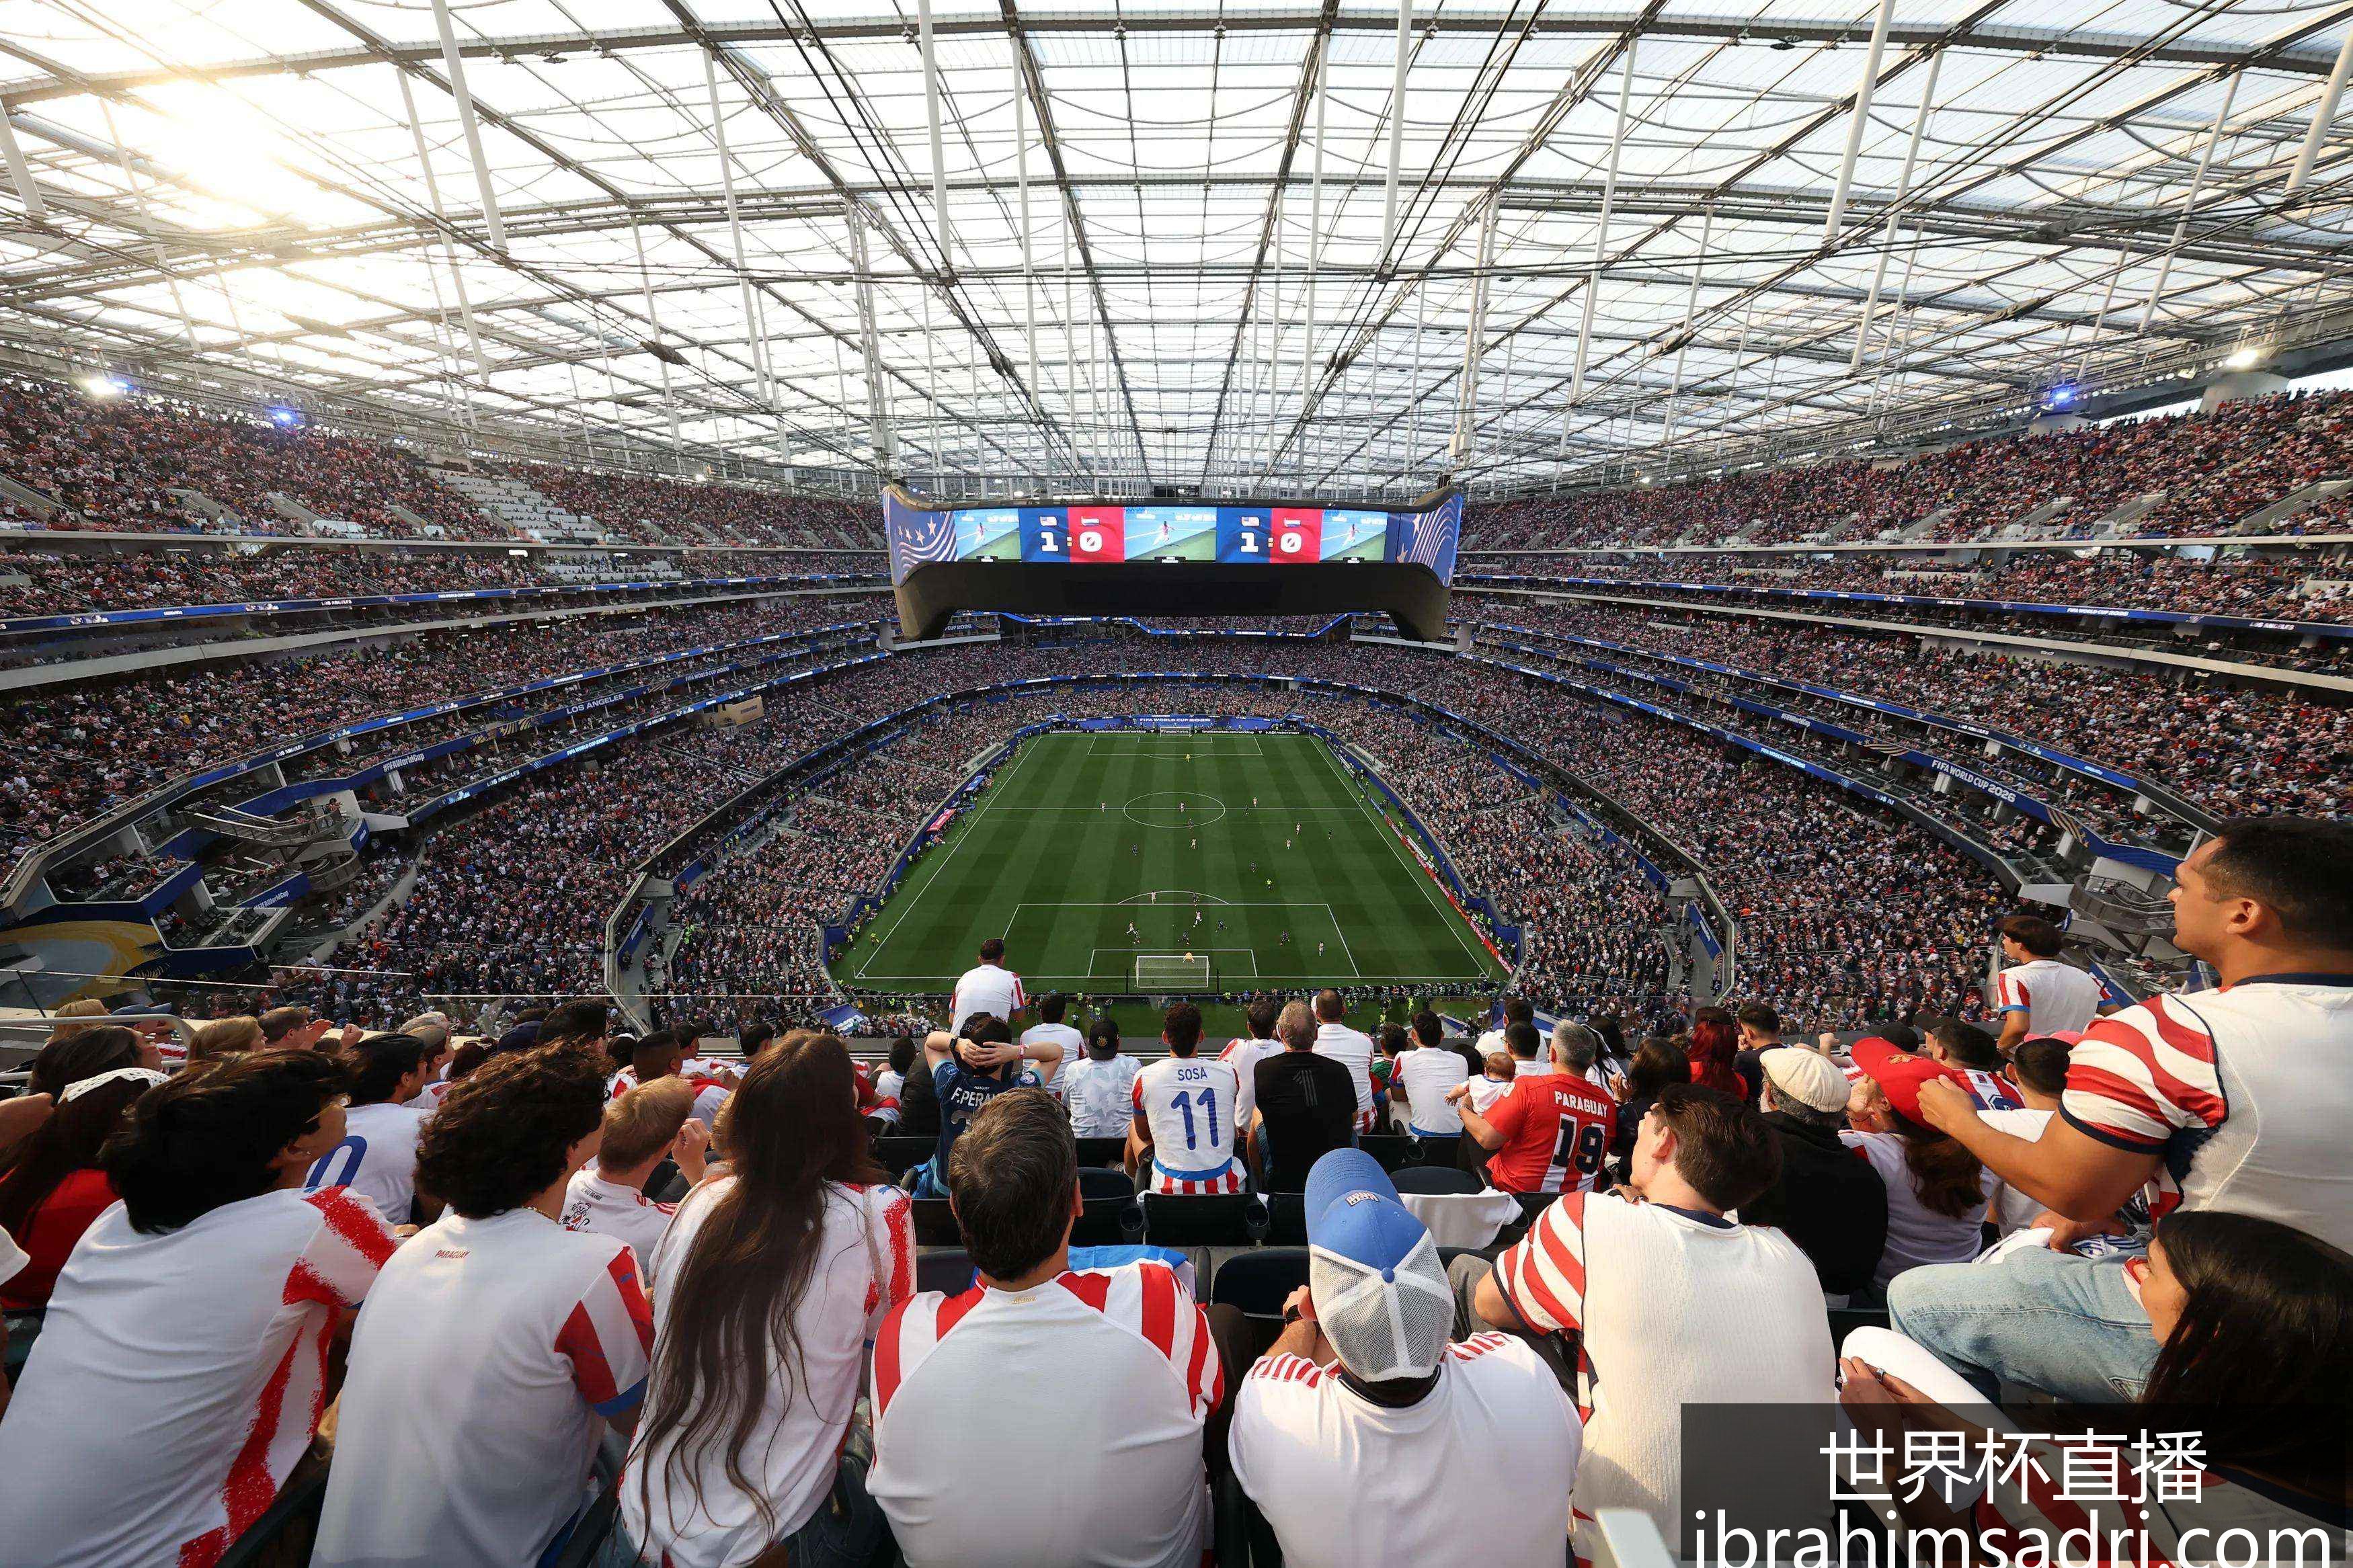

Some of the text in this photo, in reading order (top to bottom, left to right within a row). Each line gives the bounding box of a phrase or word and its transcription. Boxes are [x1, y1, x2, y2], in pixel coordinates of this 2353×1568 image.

[1615, 667, 1655, 682] LOS ANGELES
[566, 694, 624, 715] LOS ANGELES
[1931, 759, 2016, 802] FIFA WORLD CUP 2026
[1178, 1067, 1207, 1081] SOSA
[1554, 1090, 1608, 1118] PARAGUAY
[1170, 1087, 1220, 1150] 11
[1550, 1113, 1605, 1175] 19
[434, 1249, 471, 1258] PARAGUAY
